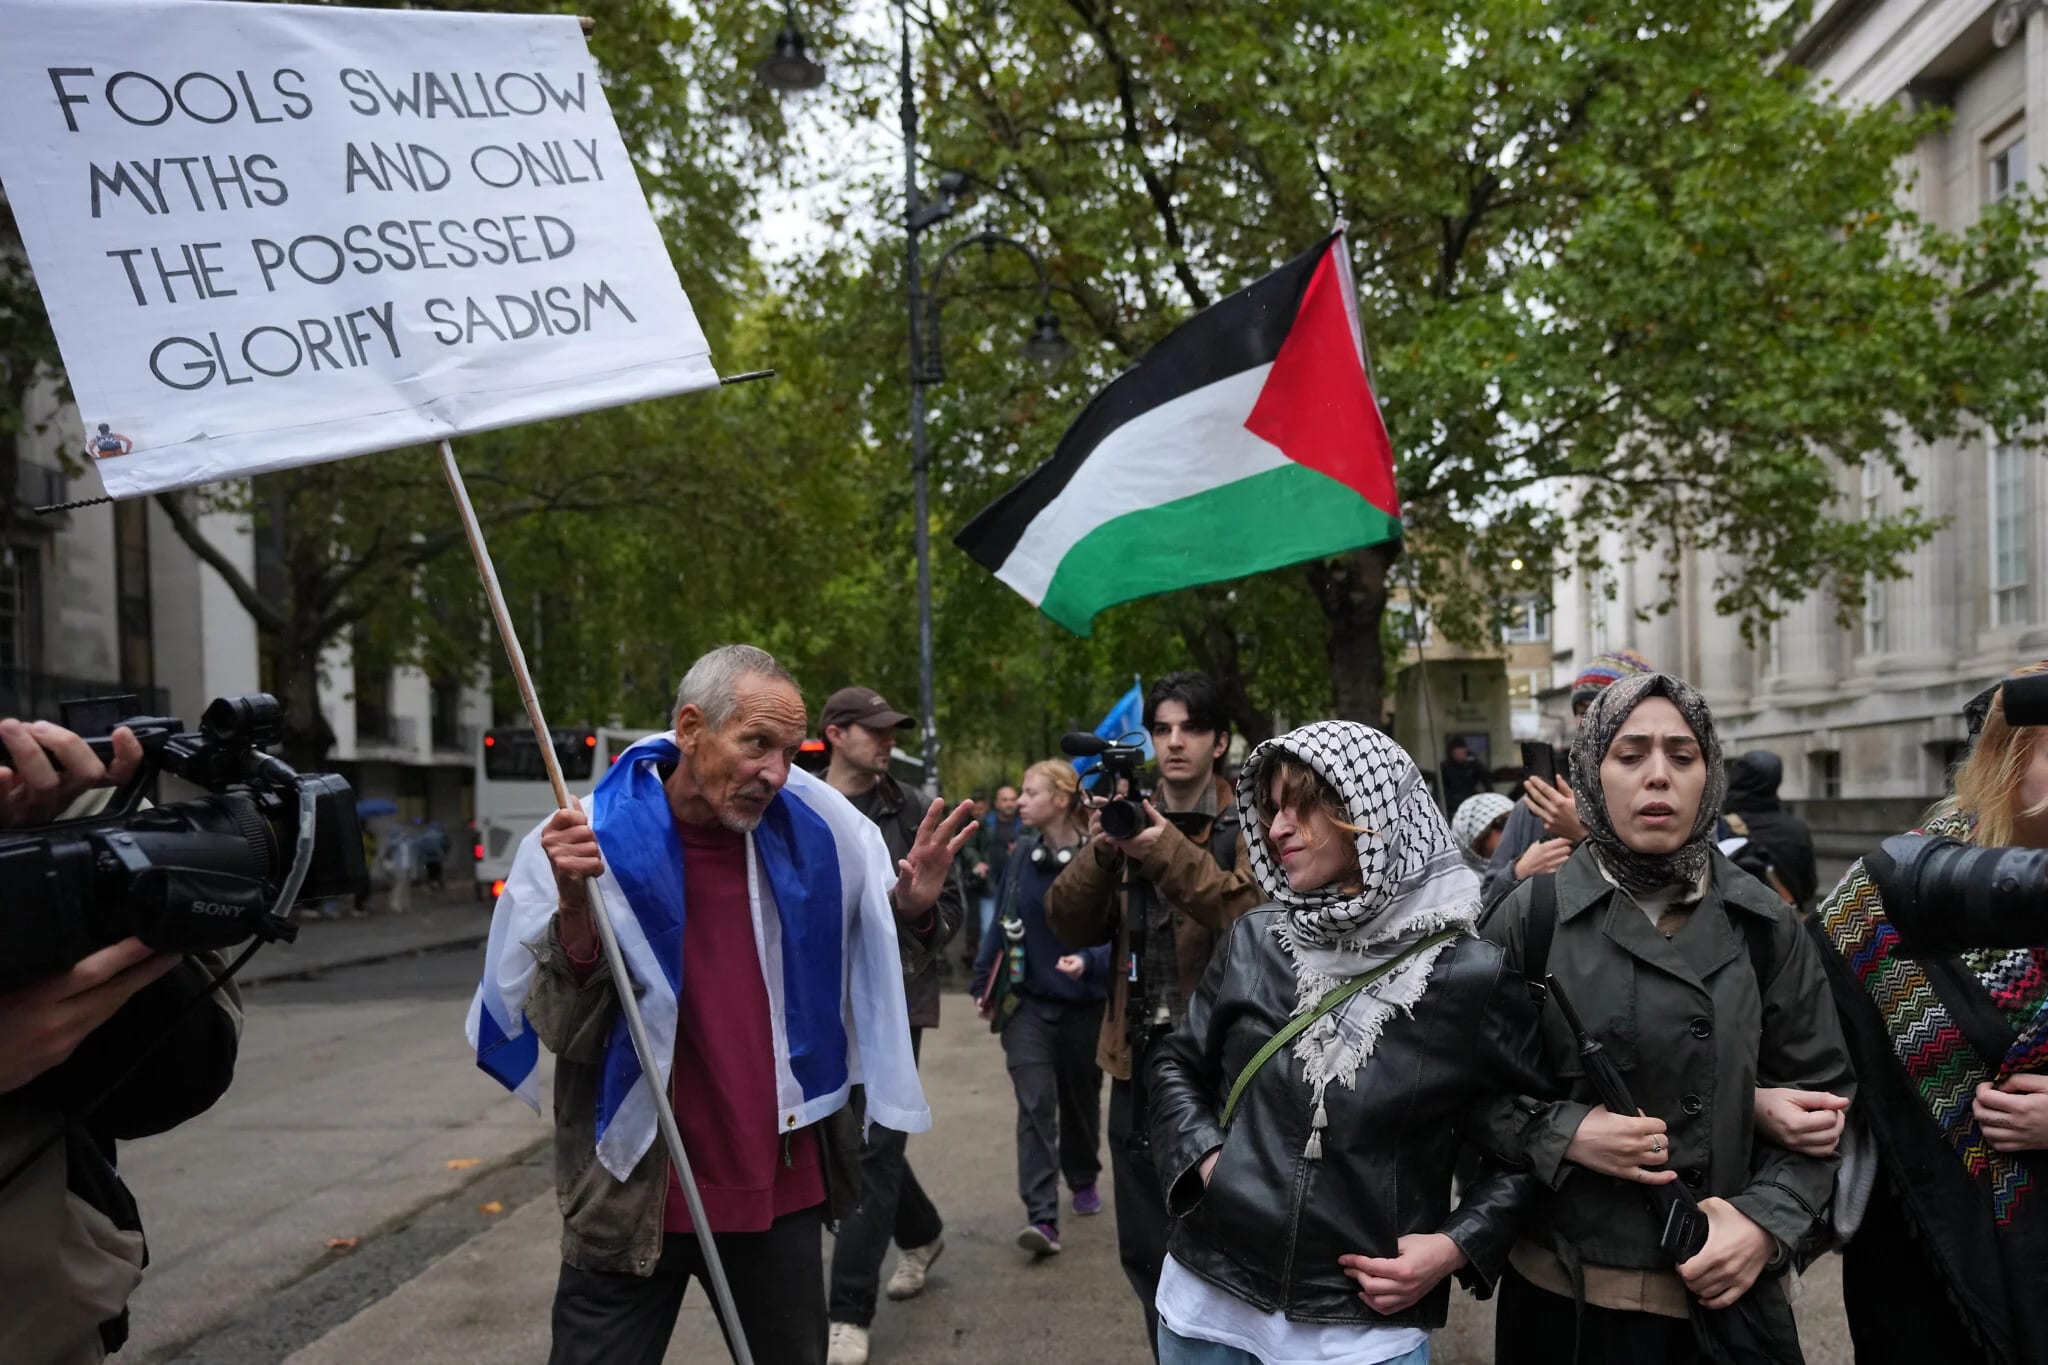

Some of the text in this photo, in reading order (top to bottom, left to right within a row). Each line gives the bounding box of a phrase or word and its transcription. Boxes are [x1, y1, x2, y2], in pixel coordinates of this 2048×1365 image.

[48, 68, 585, 132] FOOLS SWALLOW
[90, 138, 604, 218] MYTHS AND ONLY
[106, 215, 576, 306] THE POSSESSED
[149, 279, 638, 390] GLORIFY SADISM
[191, 901, 246, 918] SONY
